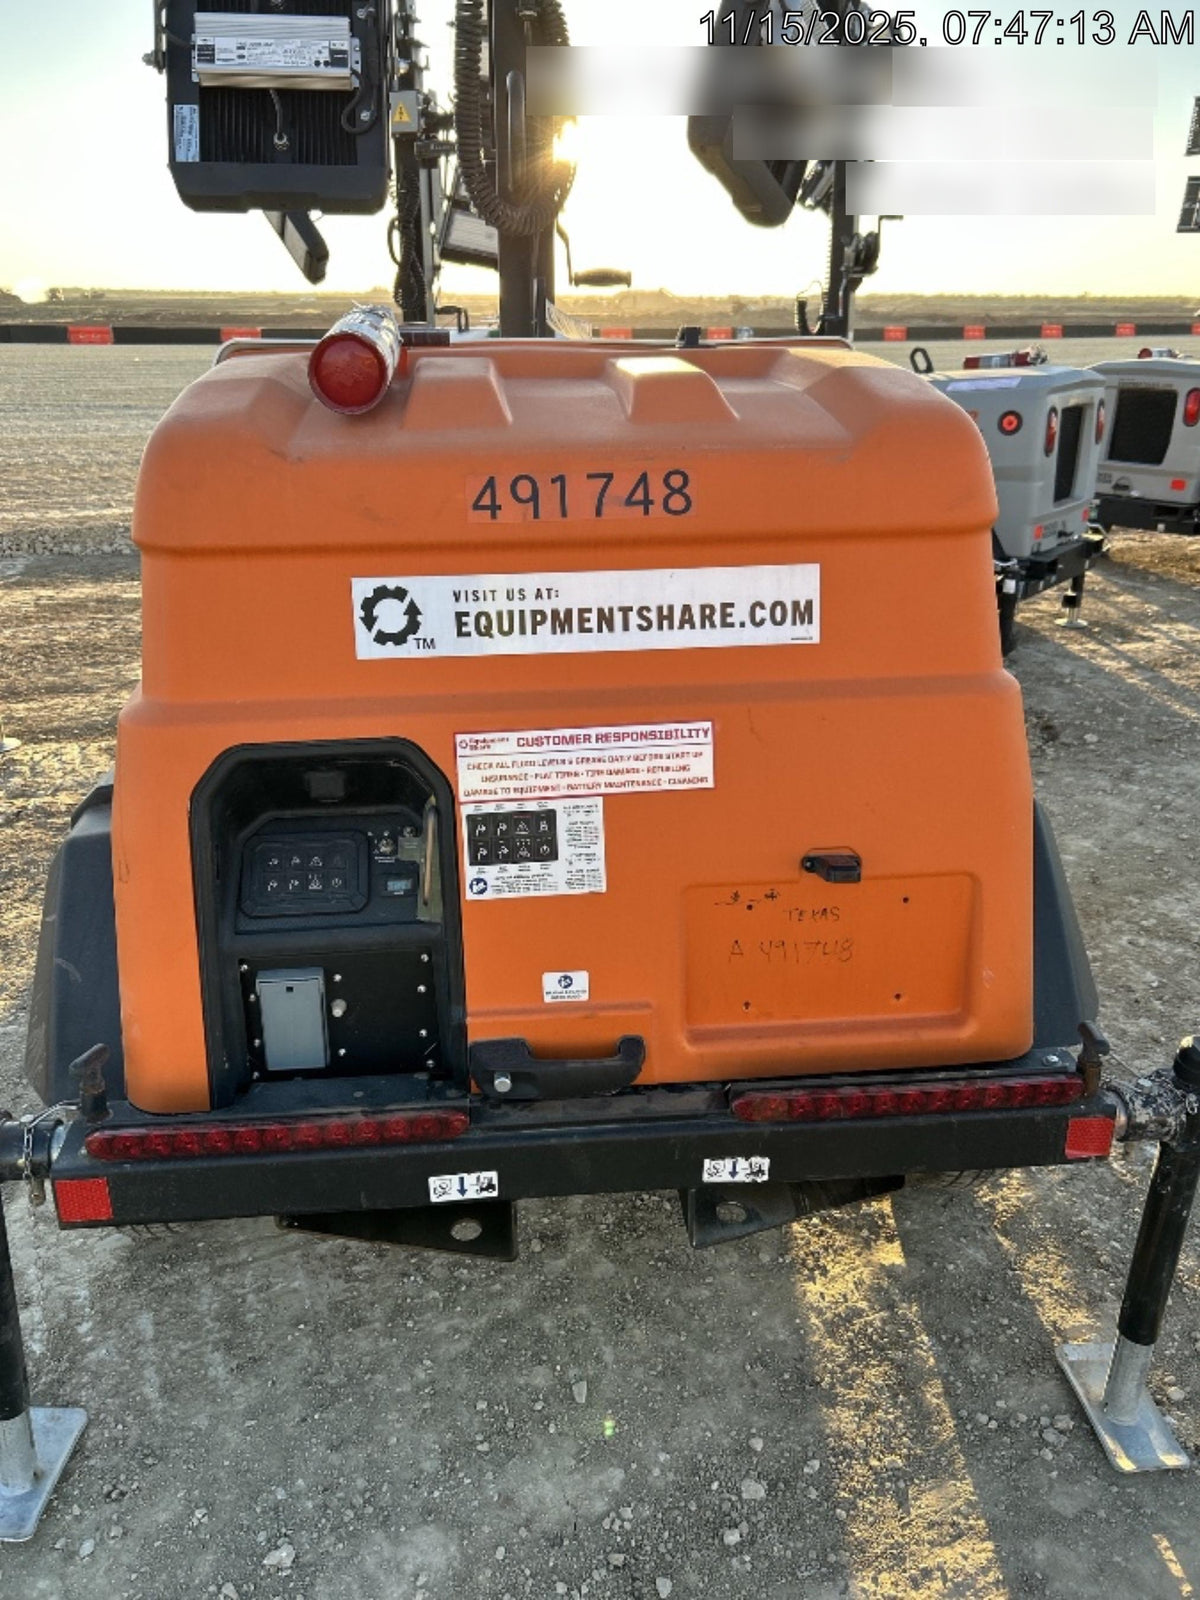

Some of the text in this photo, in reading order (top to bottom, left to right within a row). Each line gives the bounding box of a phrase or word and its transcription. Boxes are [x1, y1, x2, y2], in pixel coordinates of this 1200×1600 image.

[472, 469, 692, 519] 491748
[452, 588, 559, 602] VISIT US AT:
[455, 599, 814, 638] EQUIPMENTSHARE.COM
[413, 638, 436, 649] TM
[516, 726, 711, 748] CUSTOMER RESPONSIBILITY
